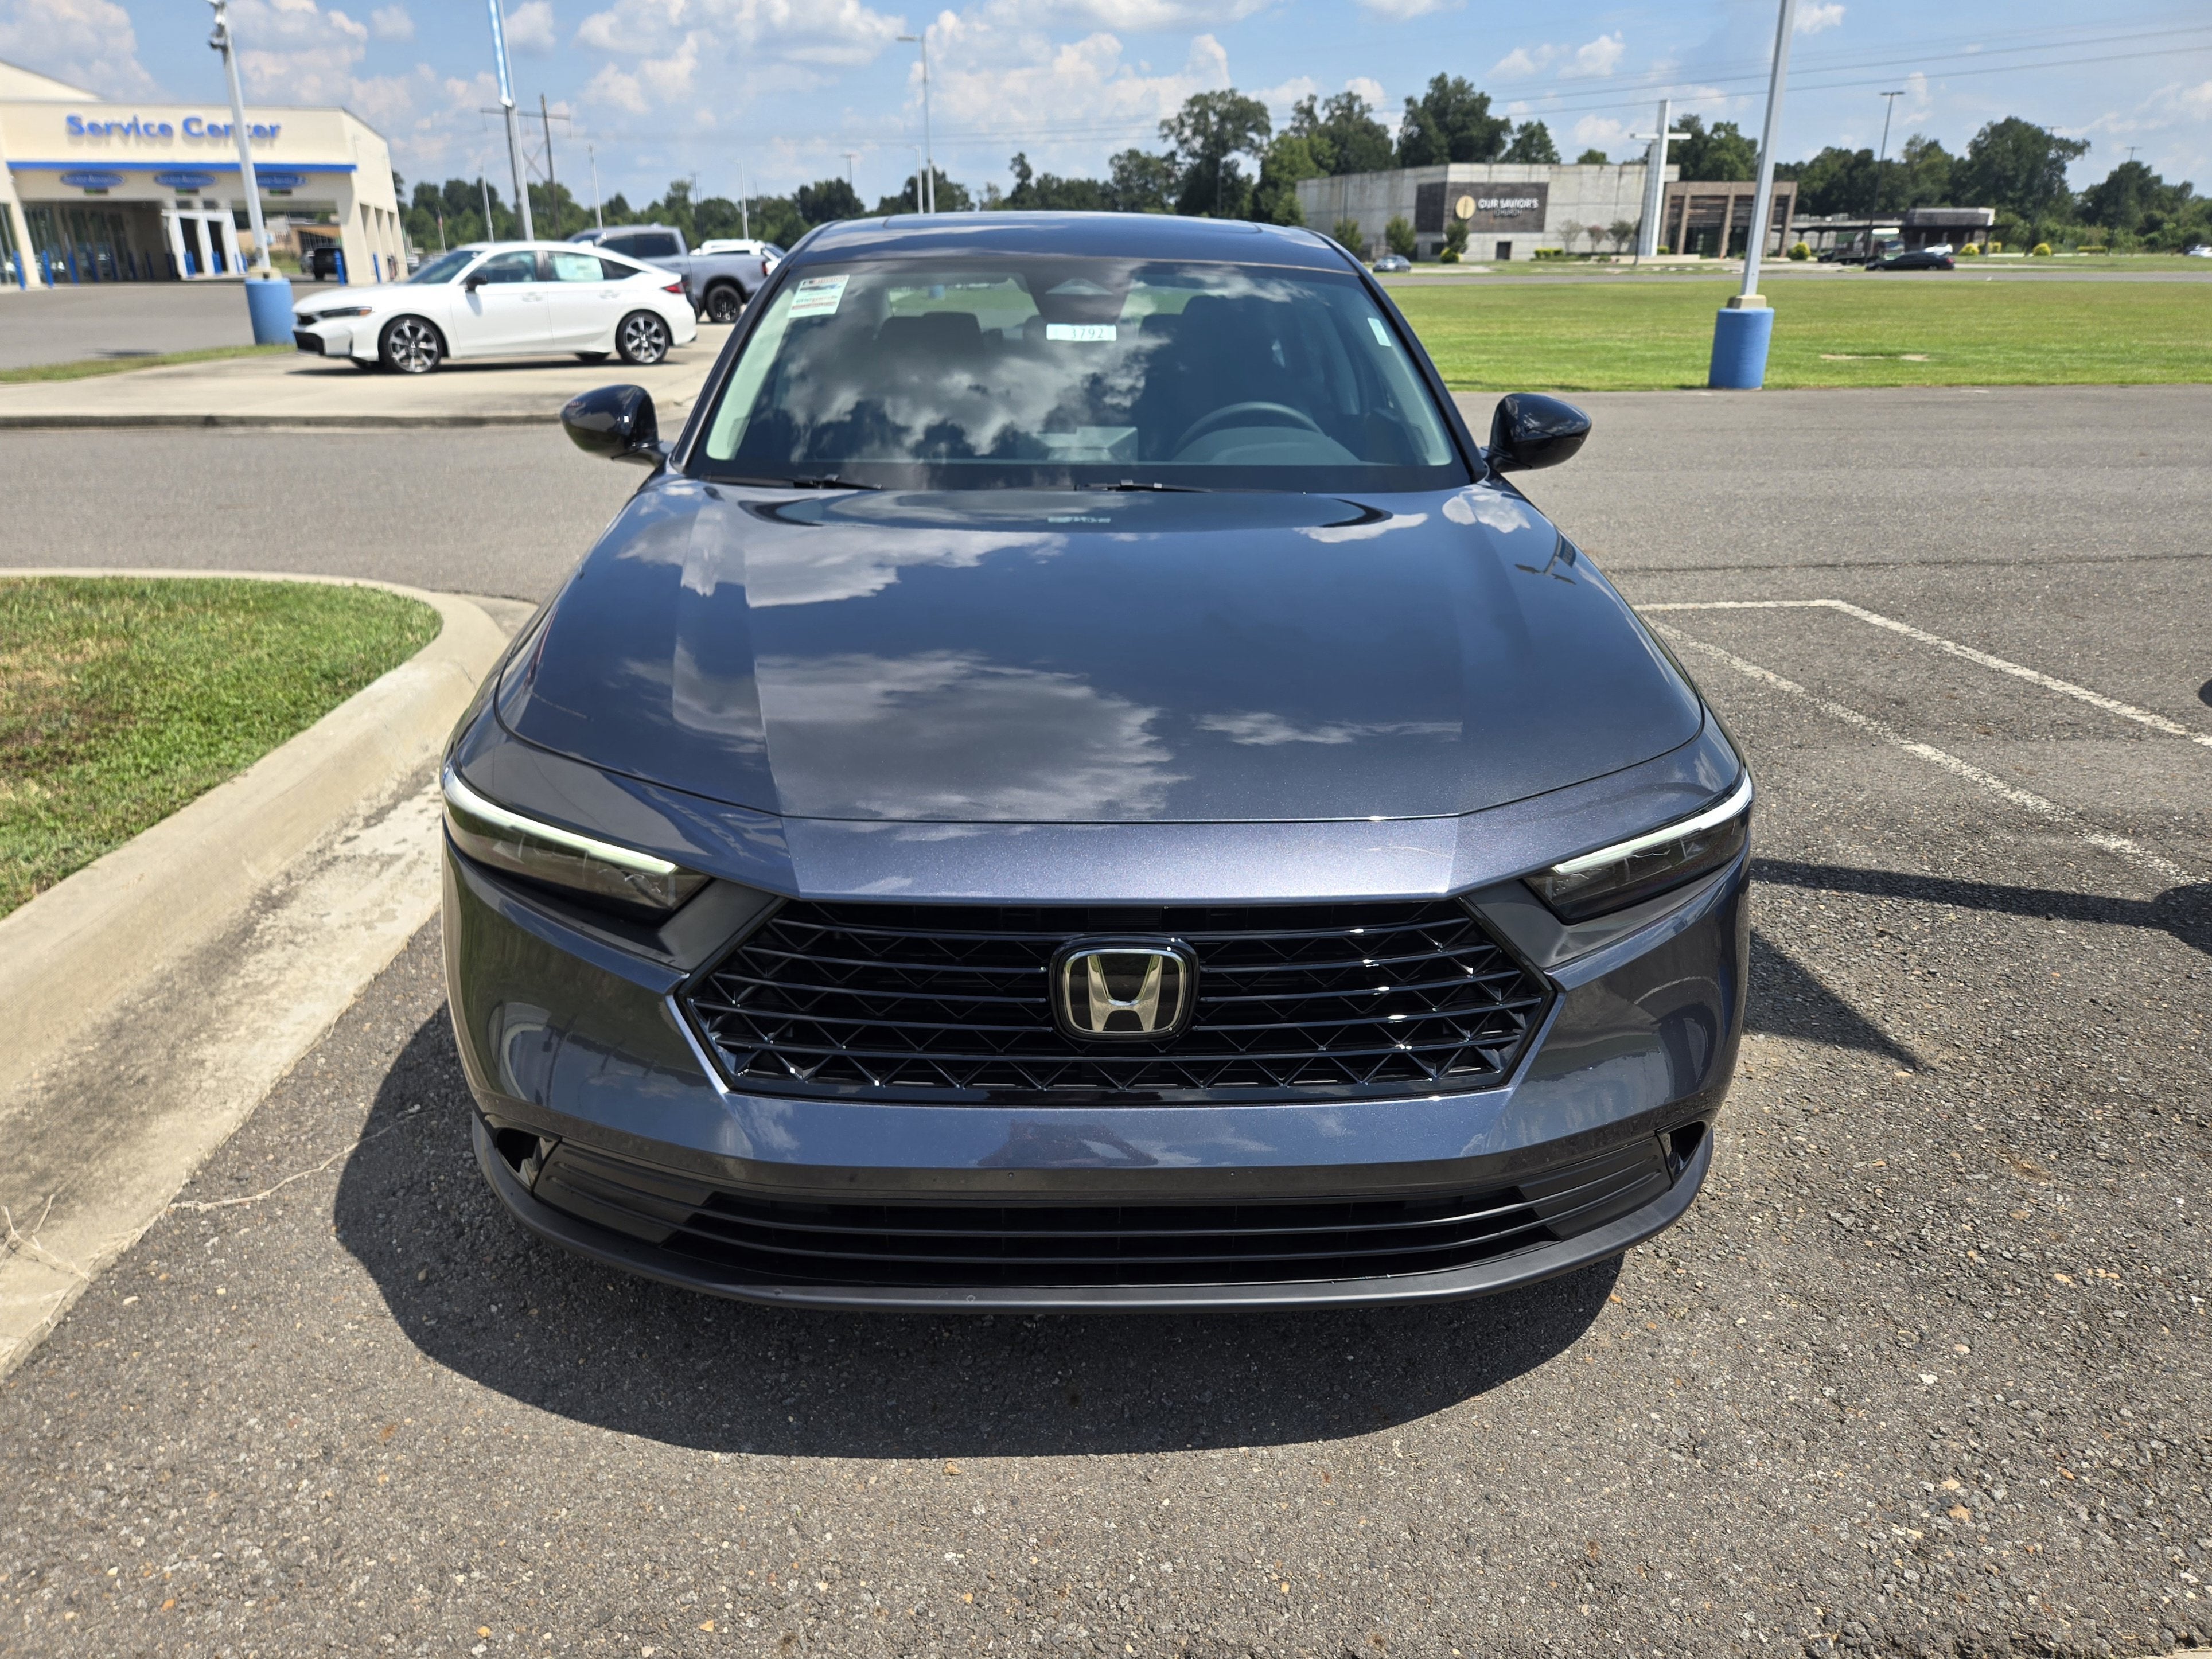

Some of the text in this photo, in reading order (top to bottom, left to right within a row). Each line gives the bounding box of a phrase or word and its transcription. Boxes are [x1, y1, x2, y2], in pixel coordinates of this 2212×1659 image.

[65, 113, 174, 137] Service
[1478, 198, 1498, 209] OUR
[1072, 328, 1104, 339] 3792
